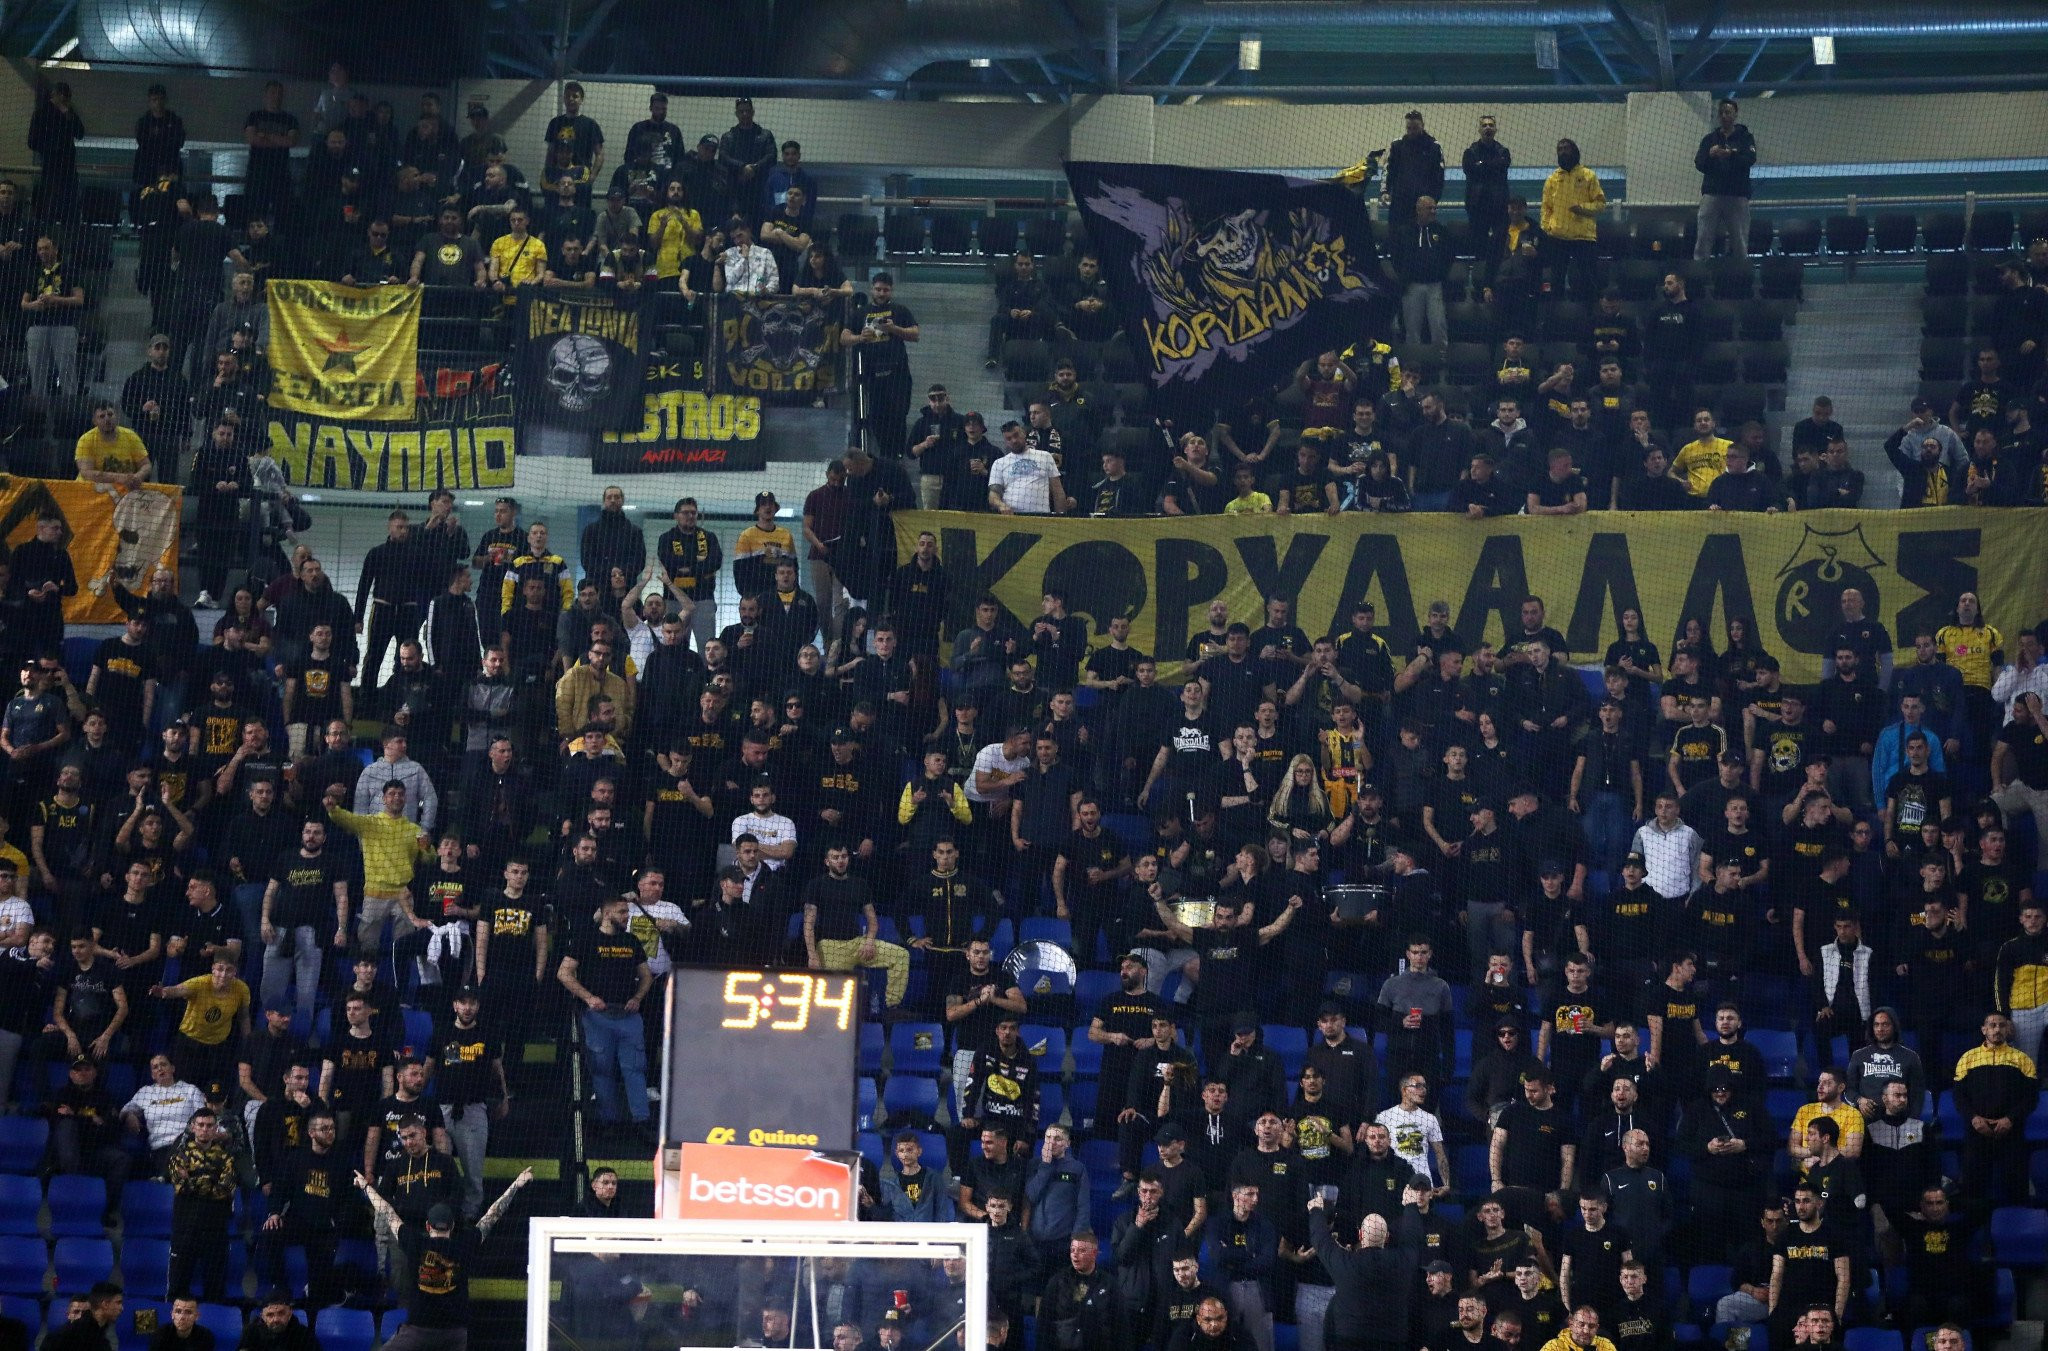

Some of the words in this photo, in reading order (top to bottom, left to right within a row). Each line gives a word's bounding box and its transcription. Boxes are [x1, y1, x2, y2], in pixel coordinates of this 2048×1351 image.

[603, 390, 761, 443] STROS
[722, 972, 855, 1030] 5:34
[1863, 1061, 1903, 1078] LONSDALE
[749, 1128, 819, 1146] Quince
[689, 1172, 840, 1210] betsson
